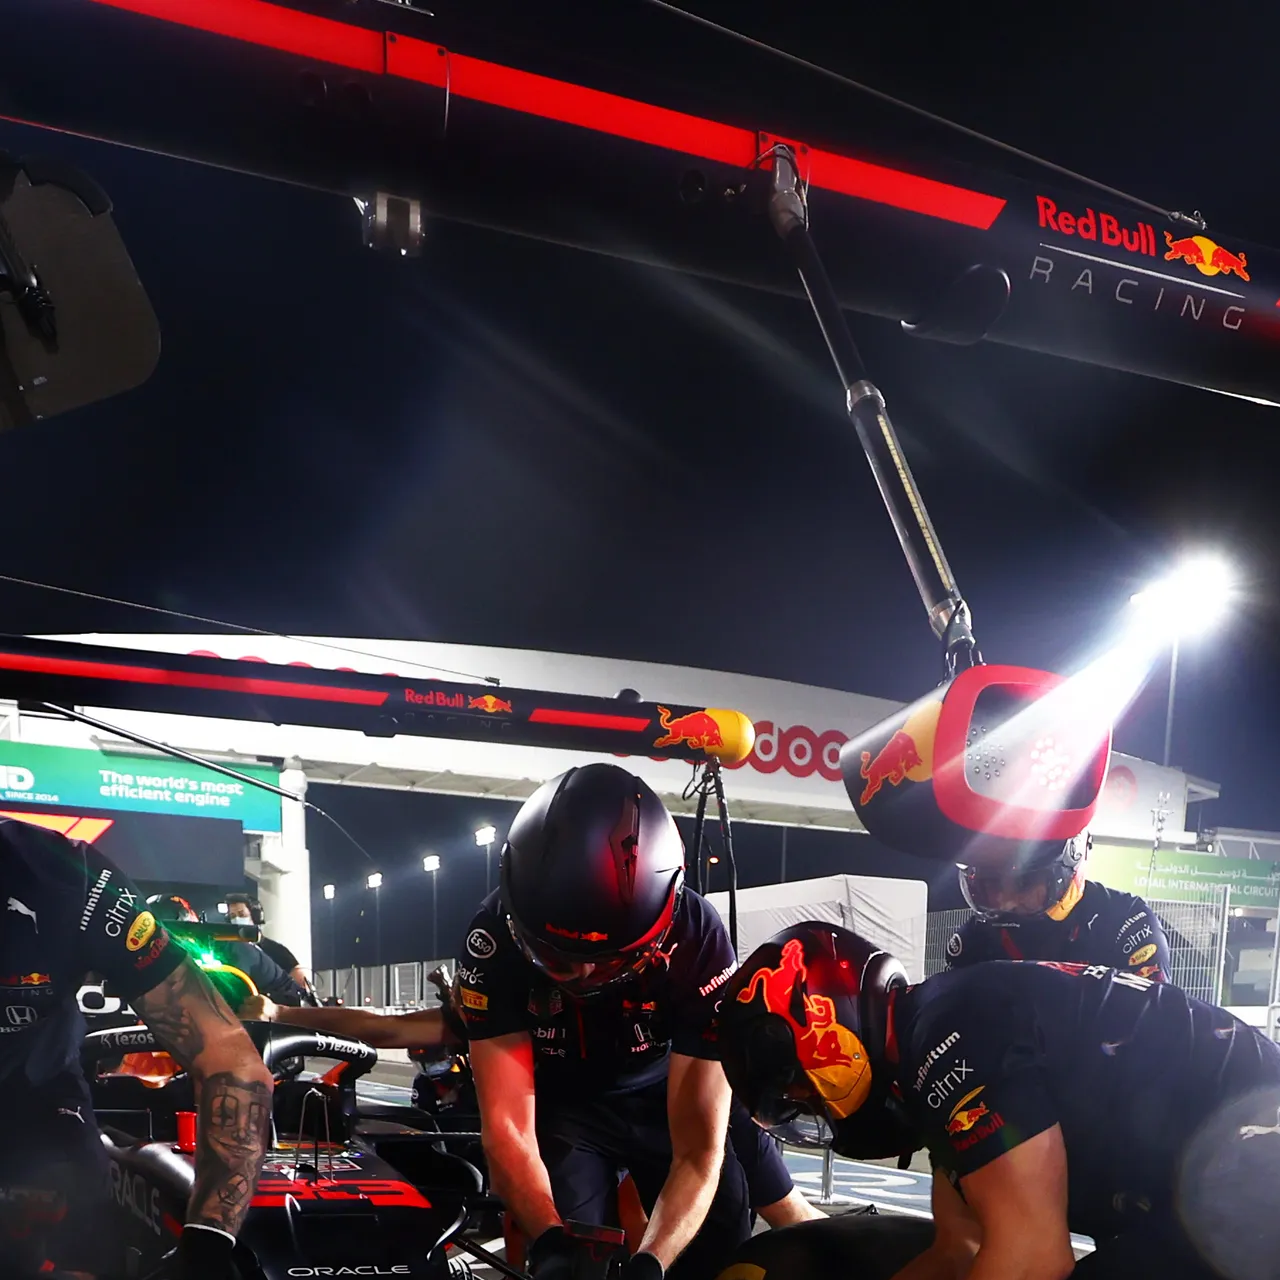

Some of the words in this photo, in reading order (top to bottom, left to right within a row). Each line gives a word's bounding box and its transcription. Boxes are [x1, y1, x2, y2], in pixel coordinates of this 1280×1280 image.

[1036, 195, 1097, 241] Red
[1100, 210, 1156, 257] Bull
[1029, 255, 1246, 331] RACING
[404, 688, 434, 705] Red
[435, 691, 465, 708] Bull
[99, 769, 127, 786] The
[129, 772, 198, 792] world's
[200, 780, 243, 796] most
[5, 790, 34, 802] SINCE
[99, 785, 172, 801] efficient
[174, 790, 231, 807] engine
[1168, 878, 1241, 895] INTERNATIOAL
[1243, 884, 1280, 897] CIRCUIT
[105, 887, 137, 937] citrix
[1122, 924, 1153, 954] citrix
[114, 1032, 155, 1046] Tezos
[532, 1026, 557, 1040] bil
[326, 1035, 359, 1057] Tezos
[927, 1059, 975, 1109] citrix
[287, 1264, 411, 1277] ORACLE
